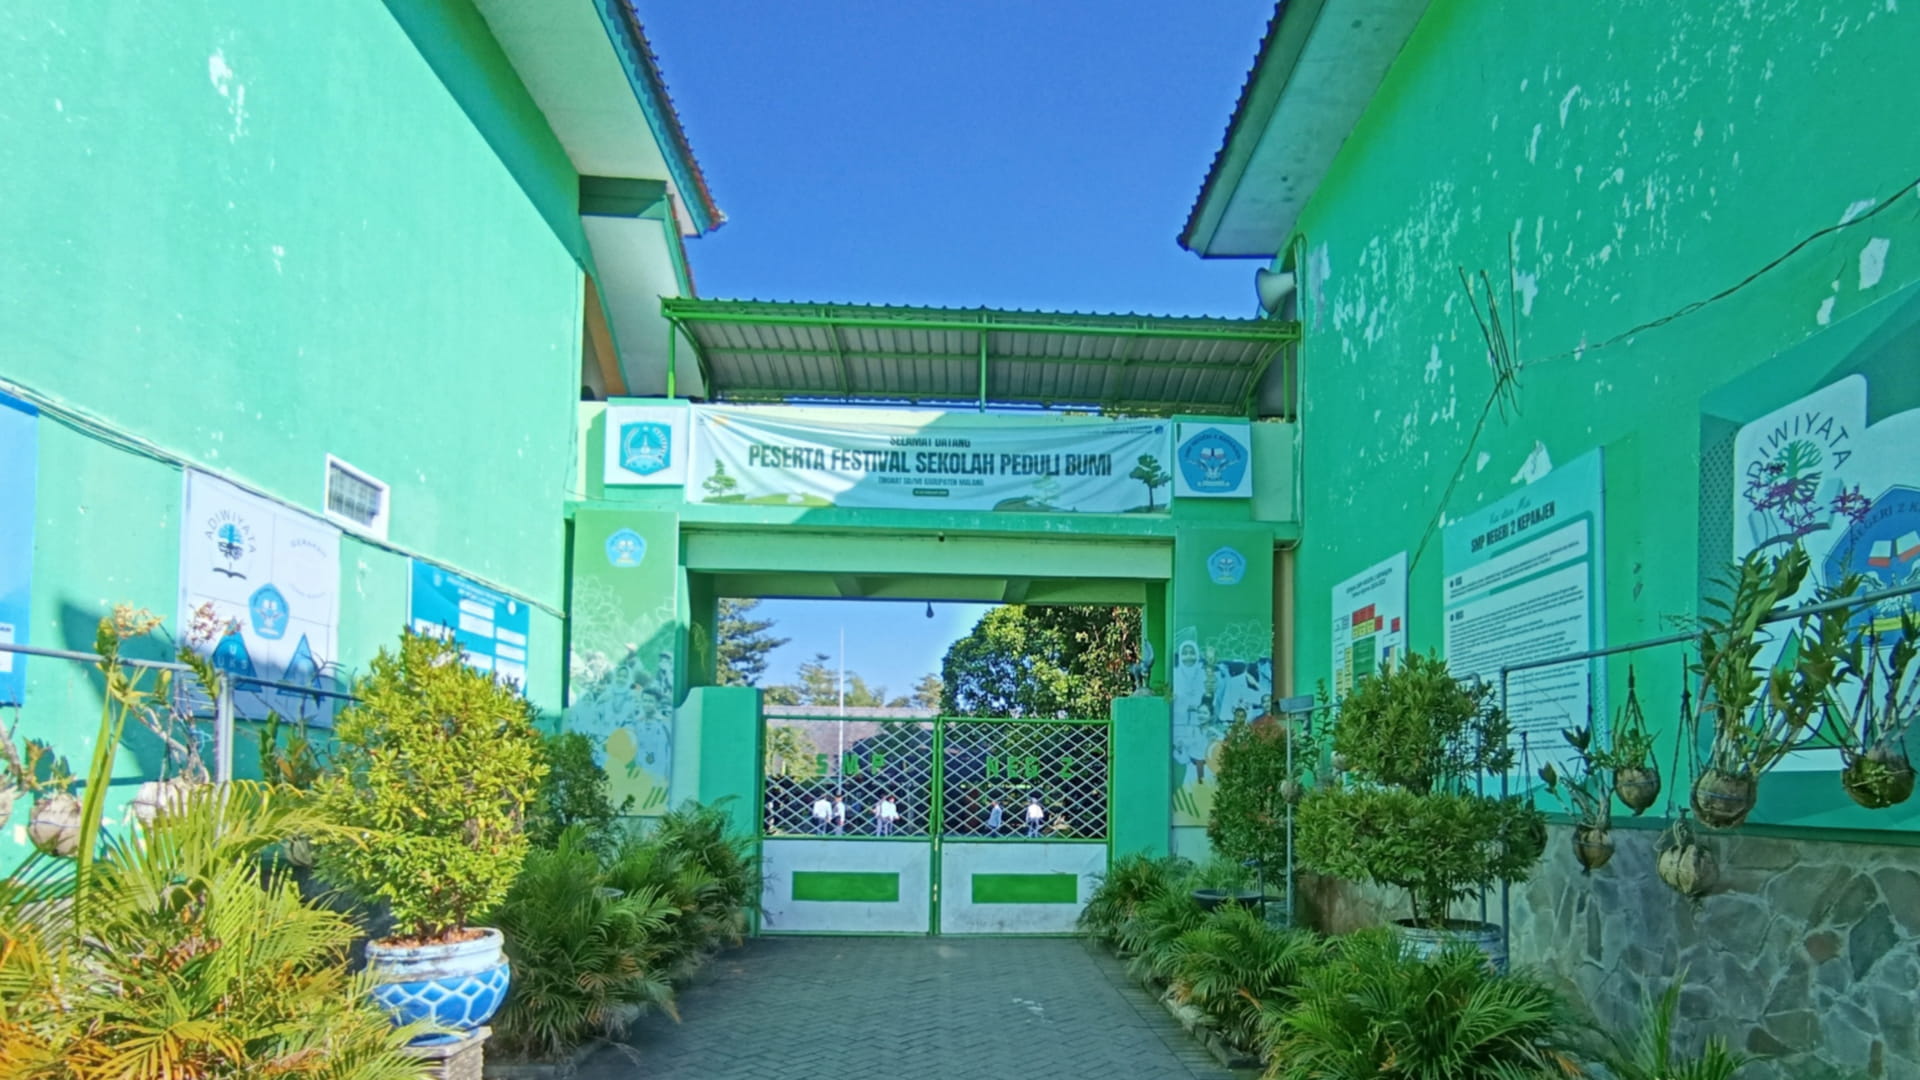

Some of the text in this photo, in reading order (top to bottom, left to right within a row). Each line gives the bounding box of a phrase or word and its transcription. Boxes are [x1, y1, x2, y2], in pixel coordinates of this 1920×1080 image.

[749, 445, 1112, 477] PESERTA FESTIVAL SEKOLAH PEDULI BUMI
[889, 437, 932, 448] SELAMAT
[1743, 412, 1852, 504] ADIWIYATA
[205, 509, 257, 554] ADIWIYATA
[1471, 533, 1485, 553] SMP
[1486, 522, 1509, 547] NEGERI
[1510, 519, 1516, 536] 2
[1517, 500, 1556, 532] KEPANJEN
[815, 753, 885, 776] SMP
[986, 755, 1041, 778] NEG
